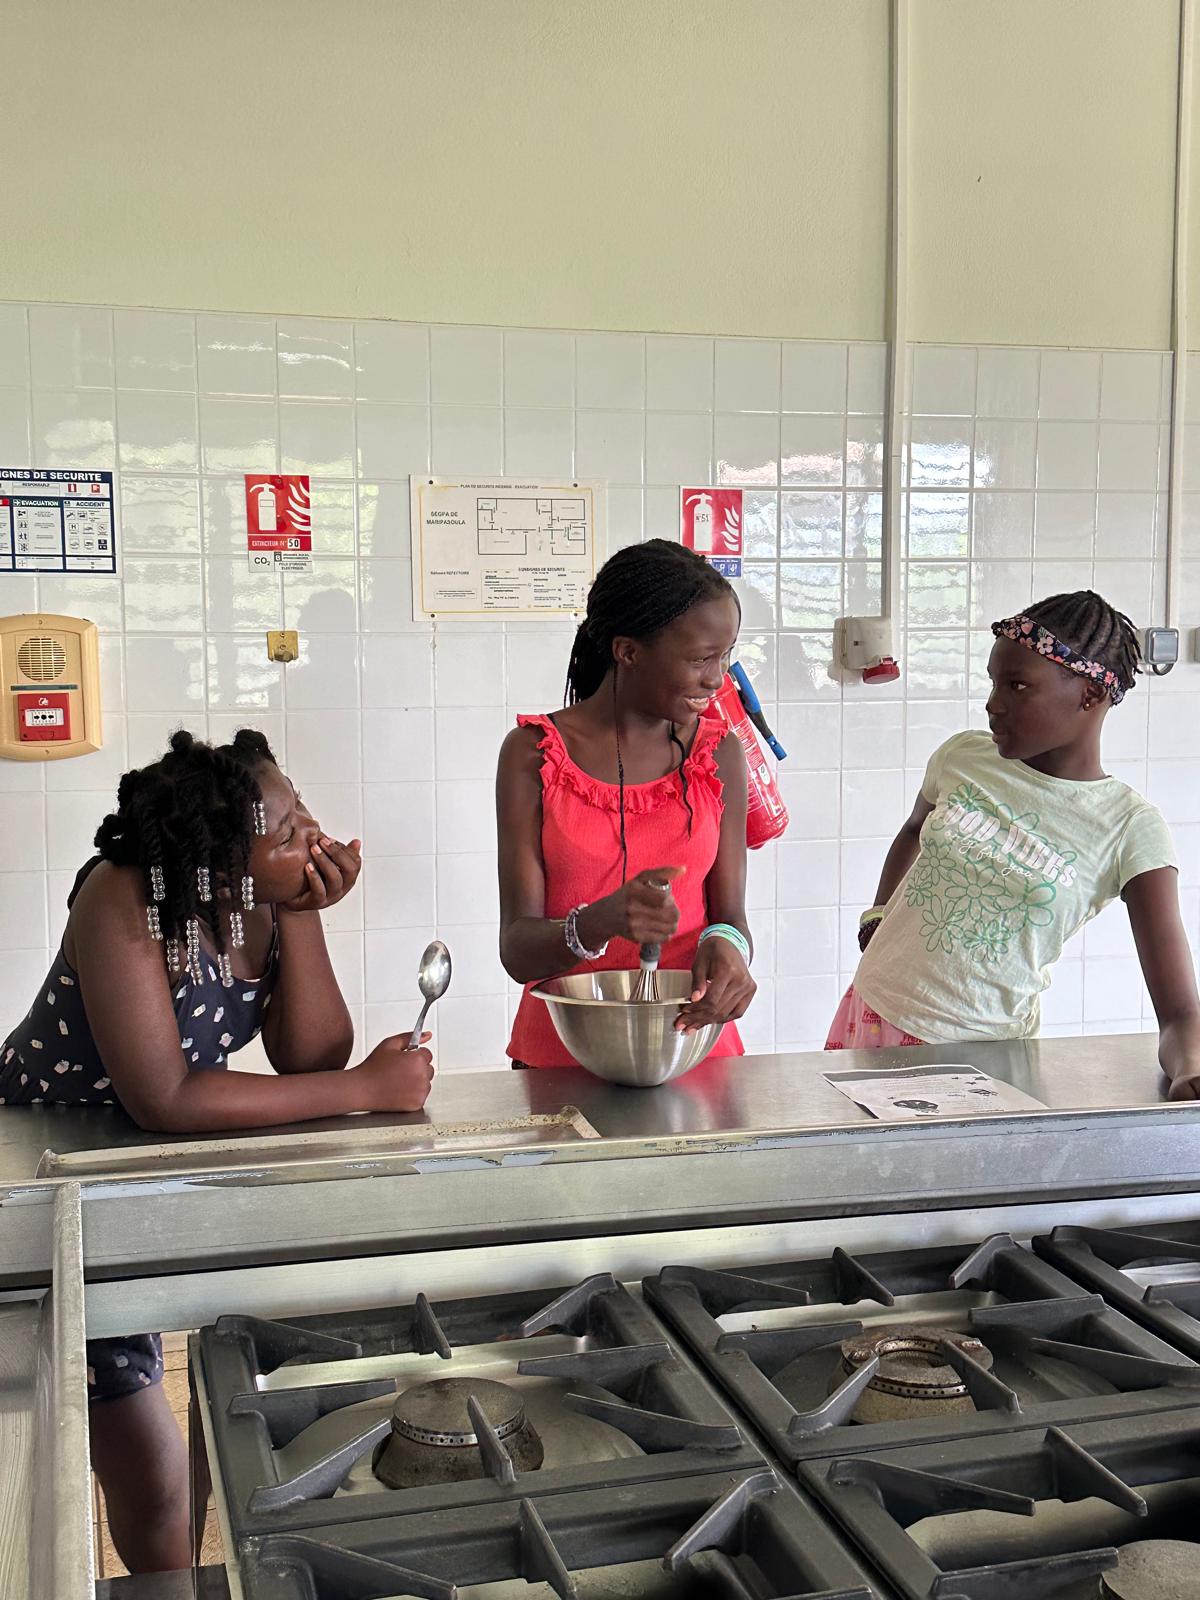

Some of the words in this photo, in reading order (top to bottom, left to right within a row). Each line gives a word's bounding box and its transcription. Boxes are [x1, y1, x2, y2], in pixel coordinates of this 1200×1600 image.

[33, 471, 47, 479] DE
[50, 472, 101, 481] SECURITE
[288, 538, 299, 548] 50
[943, 803, 1001, 842] OOD
[1001, 823, 1078, 887] VIBES
